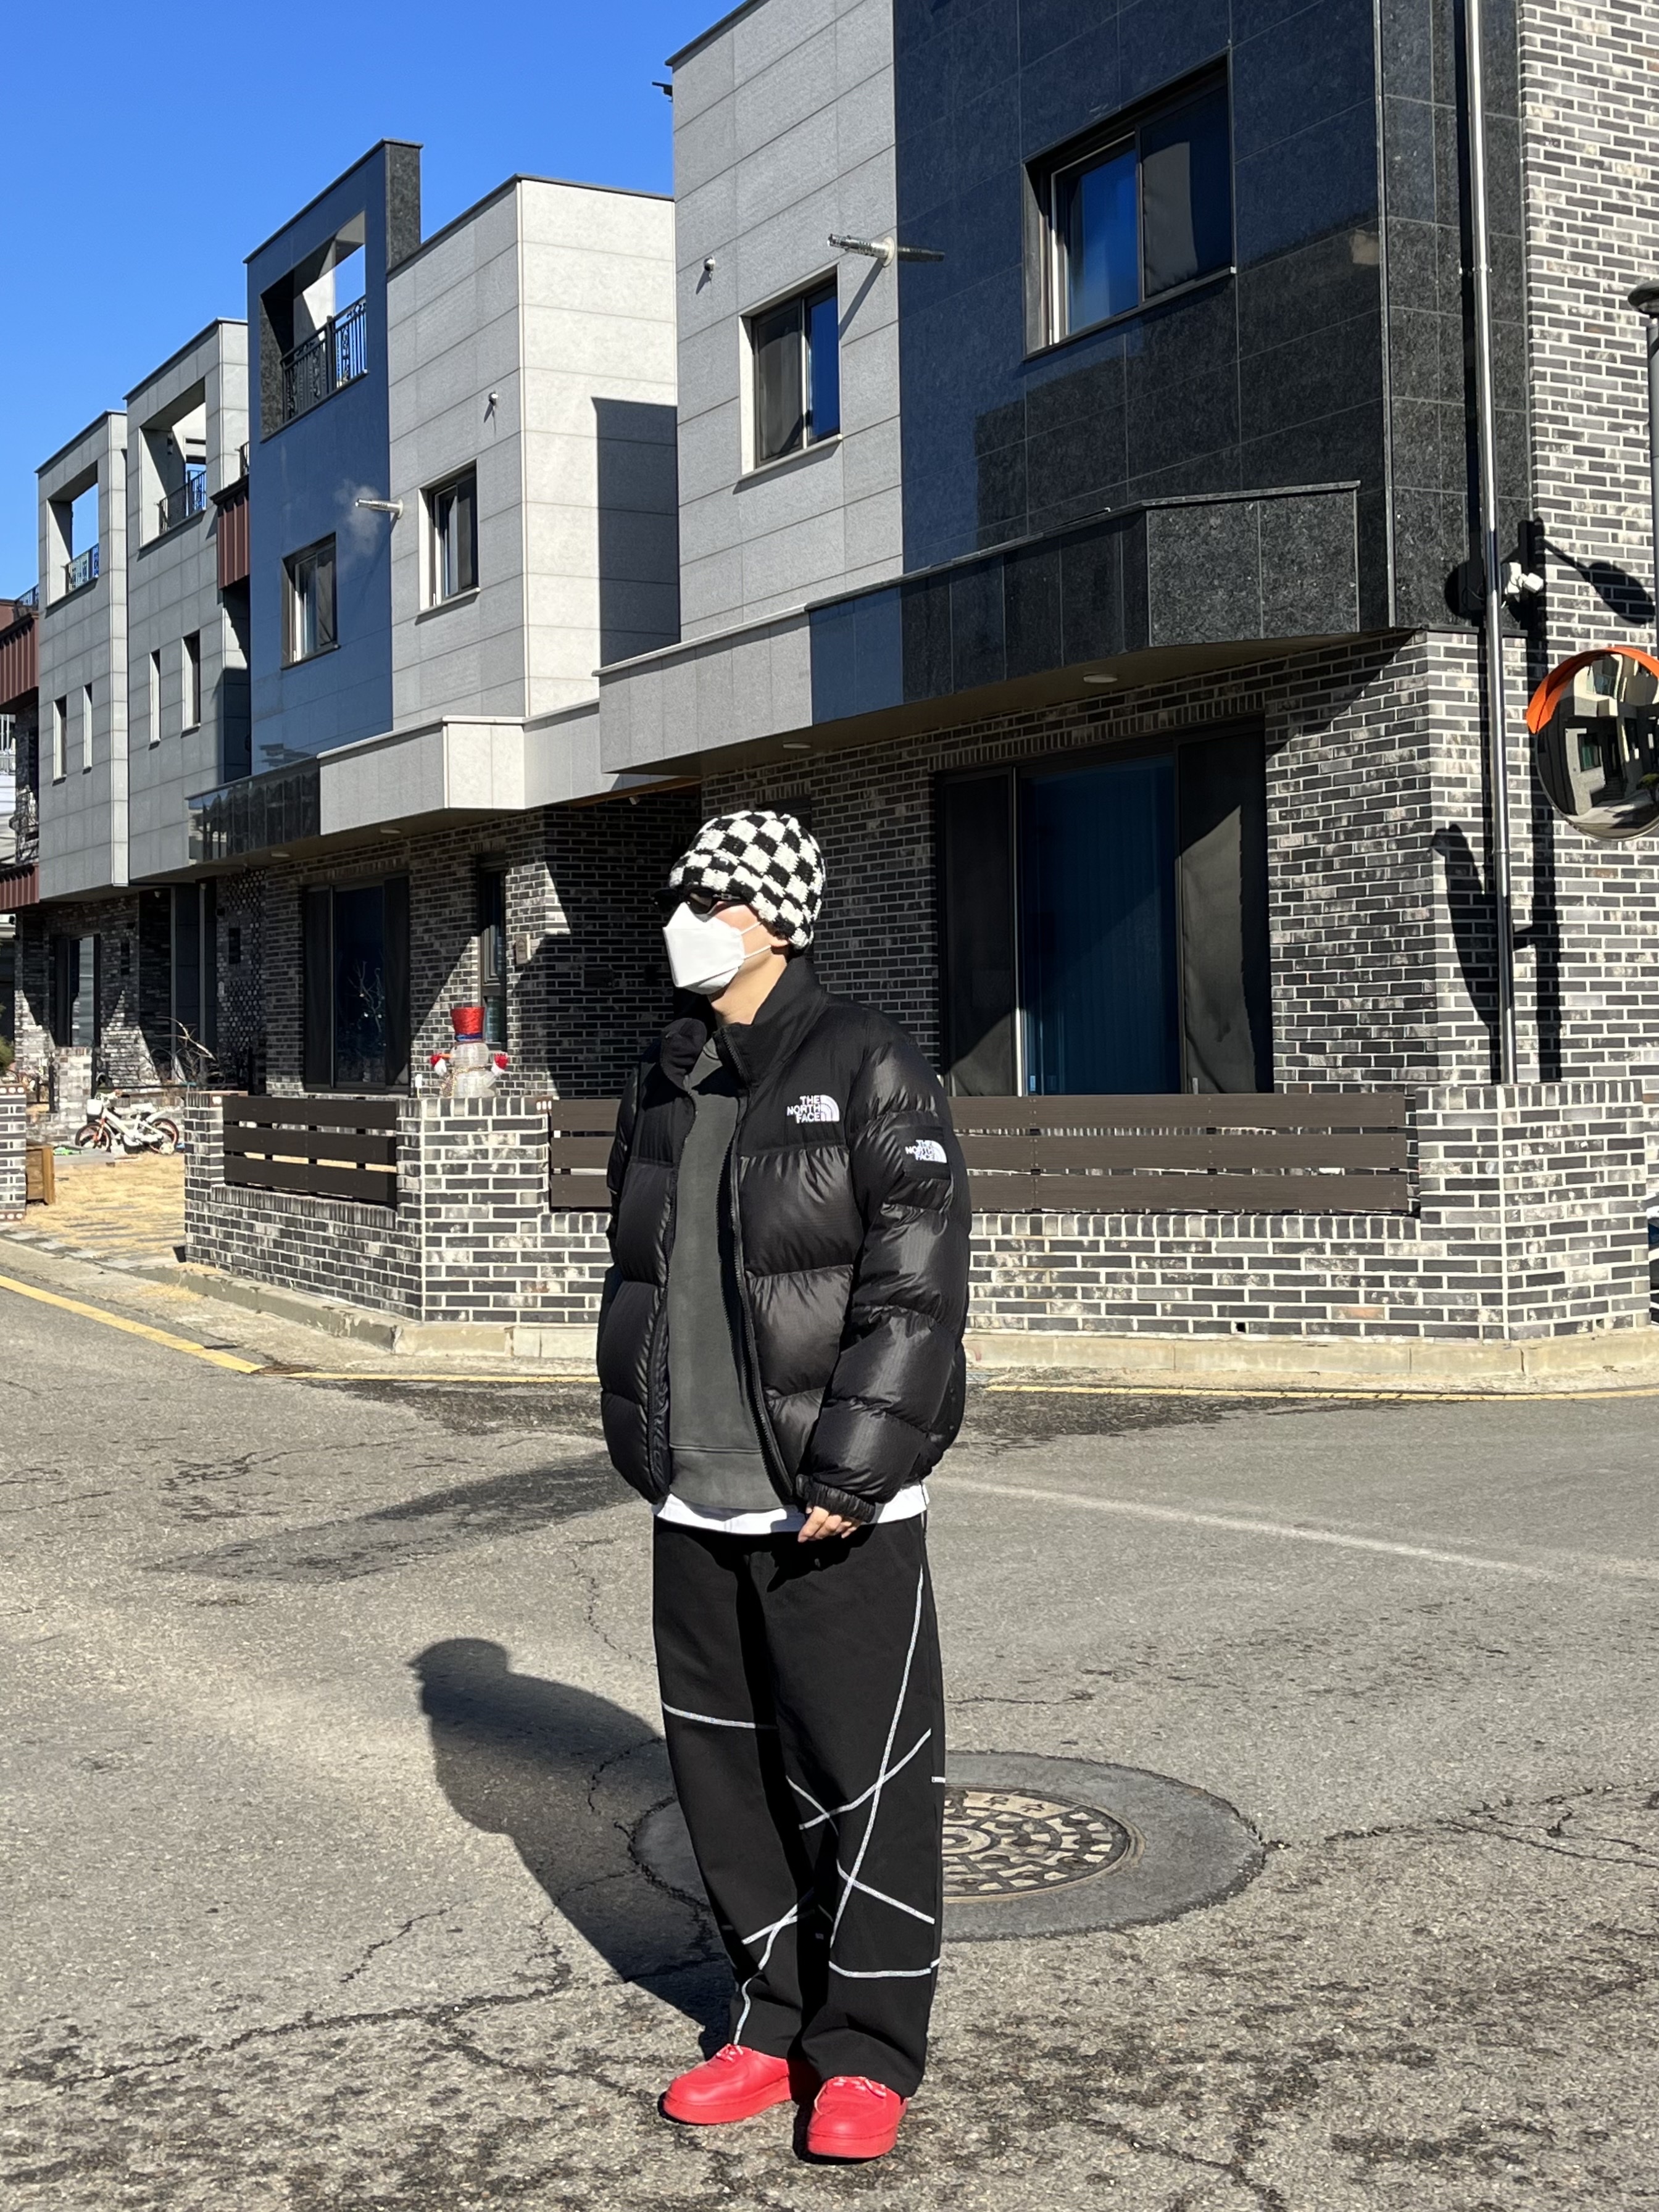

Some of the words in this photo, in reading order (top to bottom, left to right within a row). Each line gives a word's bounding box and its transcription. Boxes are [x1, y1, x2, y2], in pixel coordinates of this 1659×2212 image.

[800, 1095, 820, 1104] THE
[787, 1103, 820, 1116] NORTH
[796, 1113, 820, 1123] FACE
